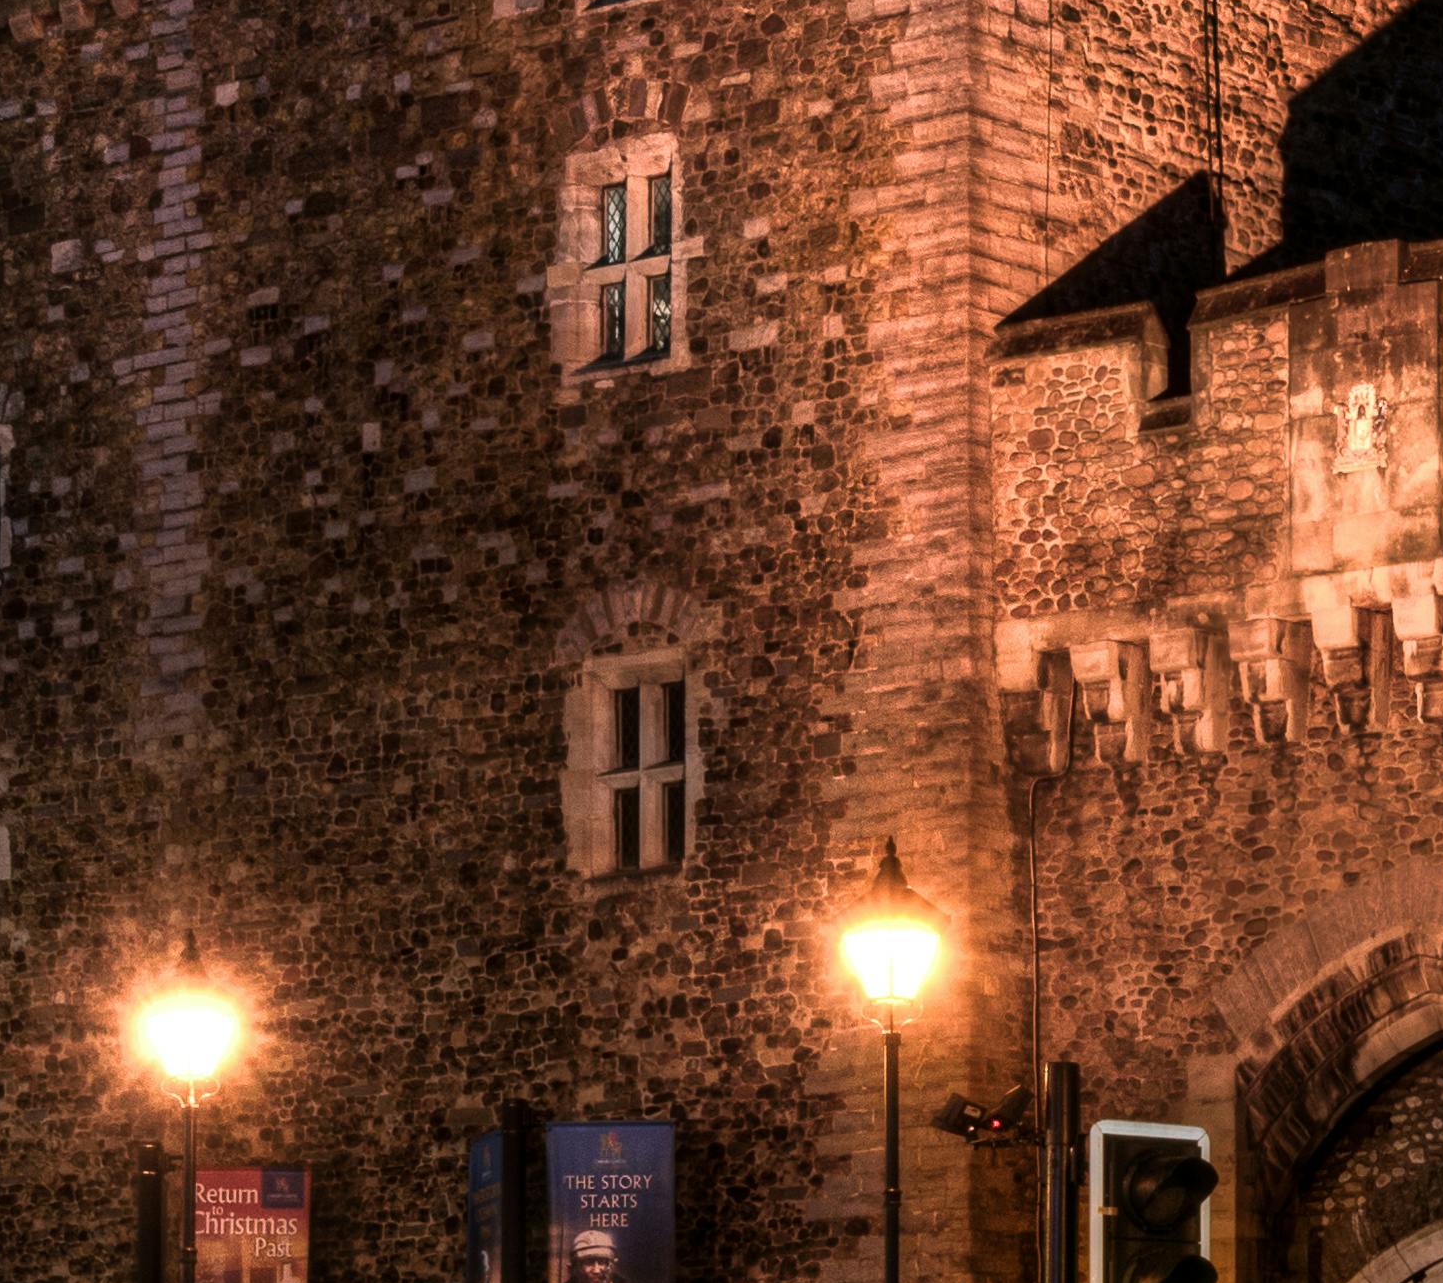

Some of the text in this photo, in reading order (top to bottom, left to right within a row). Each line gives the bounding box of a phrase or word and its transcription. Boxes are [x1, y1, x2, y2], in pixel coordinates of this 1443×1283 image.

[565, 1174, 653, 1190] THE STORY
[195, 1182, 258, 1204] Return
[580, 1193, 638, 1209] STARTS
[212, 1205, 224, 1216] to
[590, 1213, 629, 1228] HERE
[255, 1237, 293, 1258] Past
